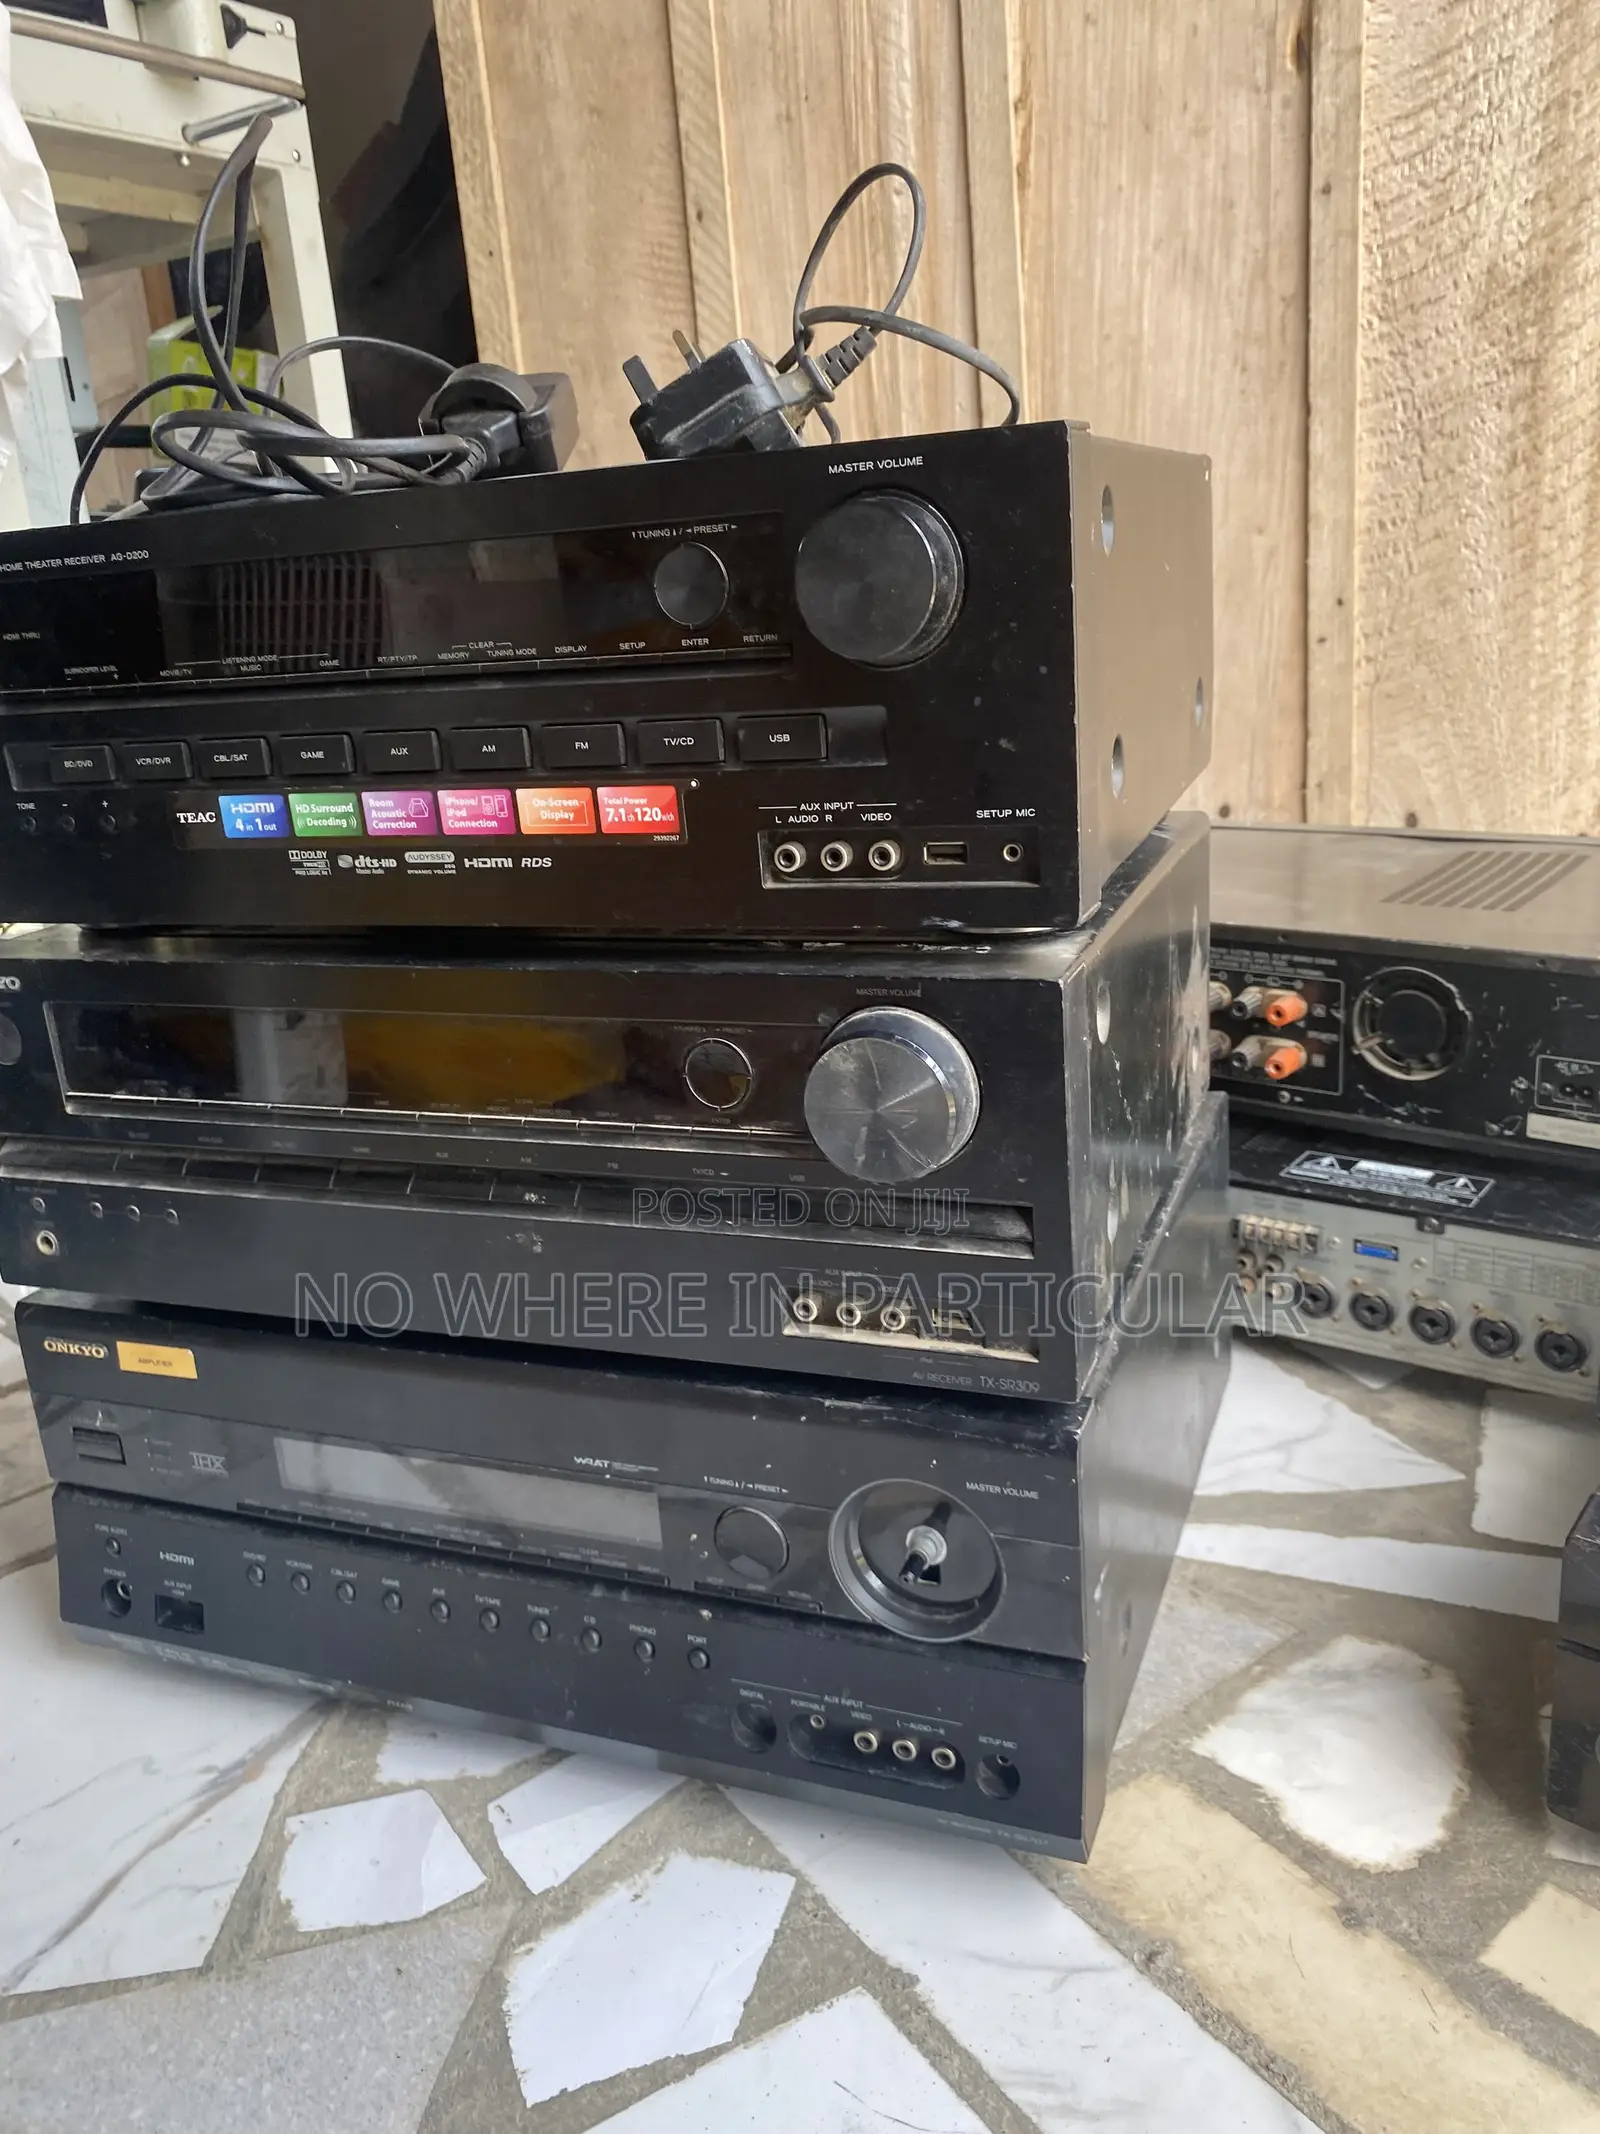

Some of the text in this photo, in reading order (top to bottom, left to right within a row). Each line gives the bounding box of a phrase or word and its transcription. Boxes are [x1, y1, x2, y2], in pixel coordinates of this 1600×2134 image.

[828, 456, 923, 475] MASTER VOLUME
[637, 523, 730, 539] TUNING PRESET
[0, 550, 149, 573] HOME THEATER RECEIVER AG-D200
[681, 637, 709, 646] ENTER
[743, 633, 778, 643] RETURN
[468, 641, 495, 650] CLEAR
[554, 645, 587, 654] DISPLAY
[619, 641, 646, 650] SETUP
[438, 652, 470, 661] MEMORY
[487, 647, 538, 657] TUNING MODE
[222, 654, 278, 666] LISTENING MODE
[319, 659, 340, 667] GAME
[240, 664, 262, 673] MUSIC
[663, 737, 694, 746] TV/CD
[769, 734, 790, 743] USB
[482, 744, 496, 753] AM
[575, 741, 589, 750] FM
[300, 751, 324, 759] GAME
[390, 747, 409, 756] AUX
[136, 757, 171, 766] VCR/DVR
[213, 754, 248, 763] CBL/SAT
[369, 798, 394, 808] Room
[532, 797, 579, 807] On-Screen
[603, 797, 648, 805] Total Power
[231, 802, 275, 814] HDMI
[296, 802, 353, 813] HD Surround
[800, 802, 854, 811] AUX INPUT
[176, 812, 217, 823] TEAC
[371, 809, 407, 818] Acoustic
[540, 810, 574, 821] Display
[860, 813, 892, 821] VIDEO
[976, 808, 1036, 819] SETUP MIC
[307, 817, 347, 828] Decoding
[373, 819, 417, 829] Correction
[448, 818, 498, 828] Connection
[775, 816, 782, 824] L
[788, 815, 819, 823] AUDIO
[301, 851, 327, 859] DOLBY
[407, 853, 452, 861] AUDYSSEY
[354, 855, 397, 868] dts-HD
[464, 857, 513, 868] HDMI
[521, 857, 552, 868] RDS
[856, 987, 888, 996] MASTER
[43, 1337, 107, 1359] ONKYO
[927, 1373, 972, 1386] RECEIVER
[574, 1456, 610, 1468] WRAT
[754, 1483, 781, 1493] PRESET
[966, 1481, 1039, 1499] MASTER VOLUME
[160, 1551, 194, 1566] HDMI
